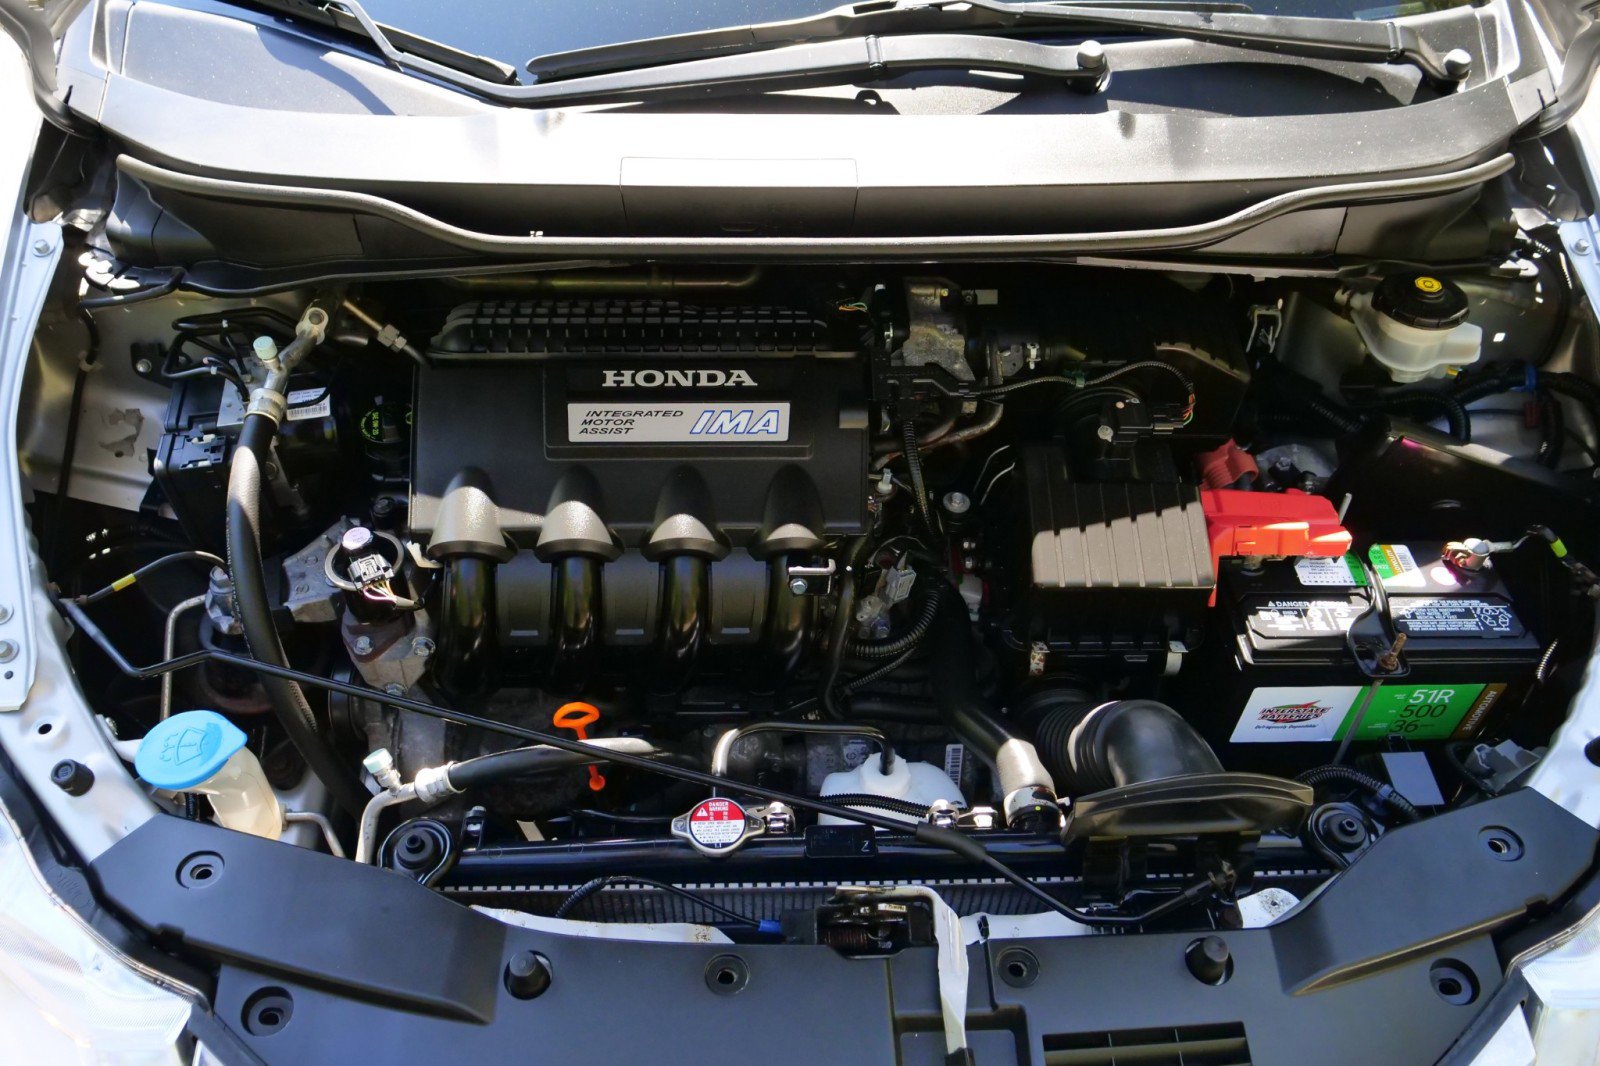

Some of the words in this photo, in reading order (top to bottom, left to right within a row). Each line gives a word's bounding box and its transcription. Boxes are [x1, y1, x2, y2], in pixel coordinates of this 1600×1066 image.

[602, 369, 758, 387] HONDA
[580, 418, 635, 426] MOTOR
[690, 409, 780, 435] IMA
[578, 427, 634, 435] ASSIST
[1408, 689, 1455, 704] 51R
[1260, 707, 1329, 715] INTERSTATE
[1399, 704, 1448, 718] 500
[1462, 690, 1497, 730] AUTOMOTIVE
[1258, 713, 1321, 721] BATTERIES
[1388, 720, 1420, 733] 36
